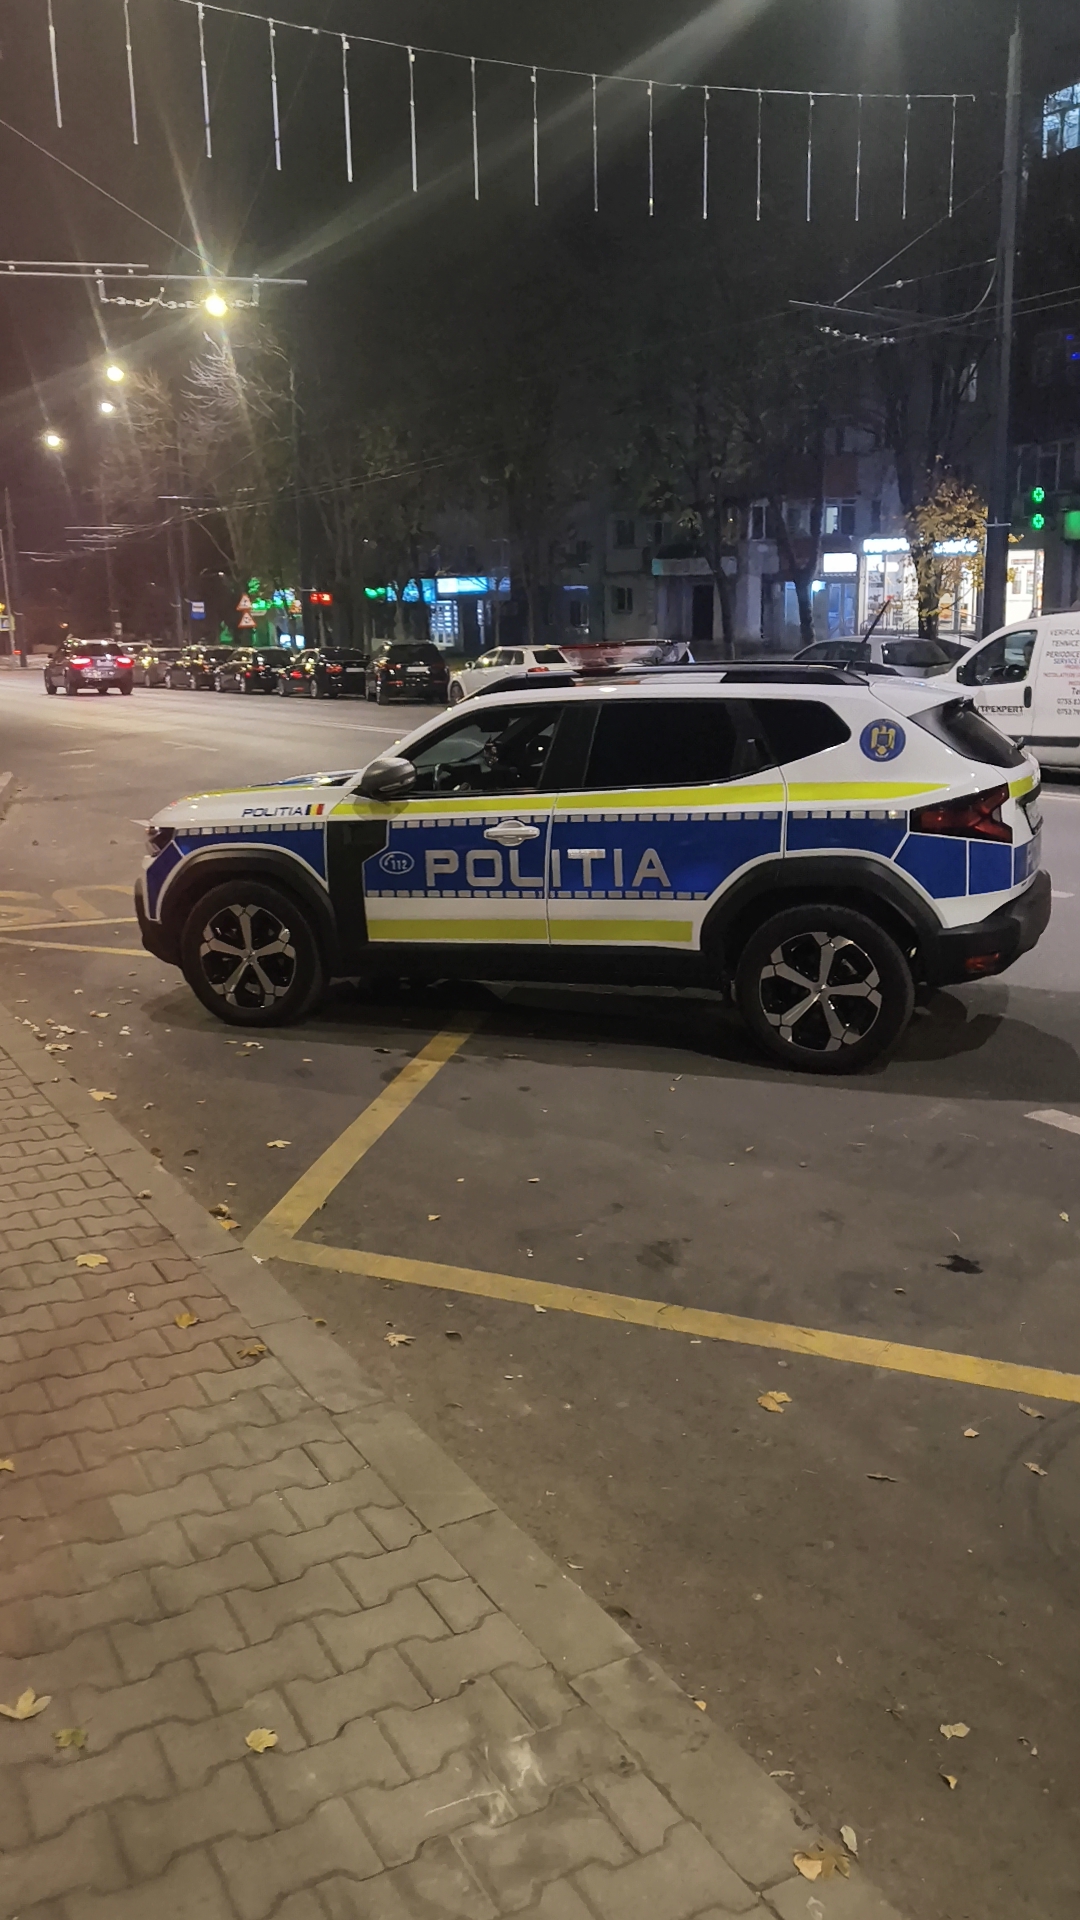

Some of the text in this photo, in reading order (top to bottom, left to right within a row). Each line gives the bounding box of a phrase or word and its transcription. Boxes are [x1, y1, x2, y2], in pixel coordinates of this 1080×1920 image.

[241, 805, 303, 818] POLITIA
[390, 859, 408, 870] 112
[425, 848, 672, 888] POLITIA
